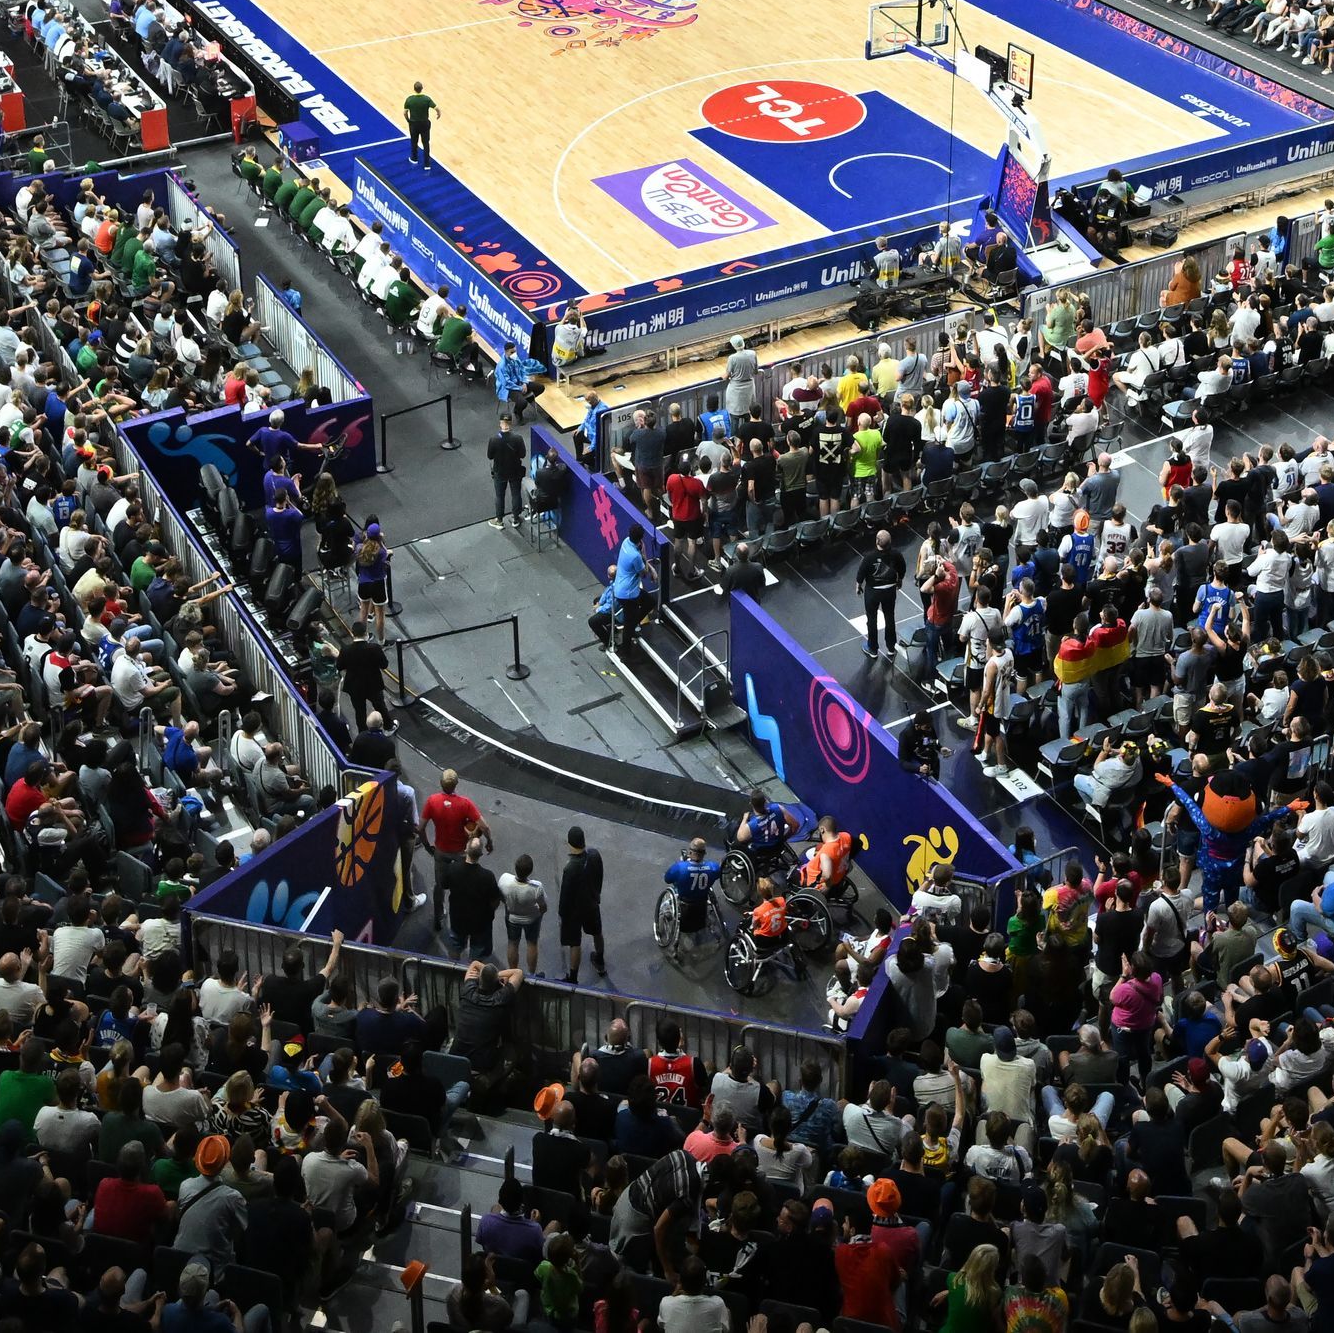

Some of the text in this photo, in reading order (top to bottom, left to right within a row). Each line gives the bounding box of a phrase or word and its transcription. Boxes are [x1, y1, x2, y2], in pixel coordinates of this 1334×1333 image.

[193, 0, 315, 96] EUROBASKET
[298, 93, 360, 135] FIBA
[744, 85, 827, 136] TCL
[1180, 94, 1250, 128] JUNCKERS
[755, 286, 793, 302] Unilumin
[1034, 295, 1047, 305] 104
[469, 281, 512, 334] Unilumin
[696, 298, 746, 318] LEDCON
[586, 319, 647, 349] ilumin
[617, 413, 632, 423] 105
[1020, 405, 1033, 420] 0
[1107, 533, 1126, 542] PIPPEN
[1106, 541, 1126, 554] 33
[1011, 776, 1028, 792] 102
[690, 872, 709, 891] 70
[655, 1086, 688, 1107] 24
